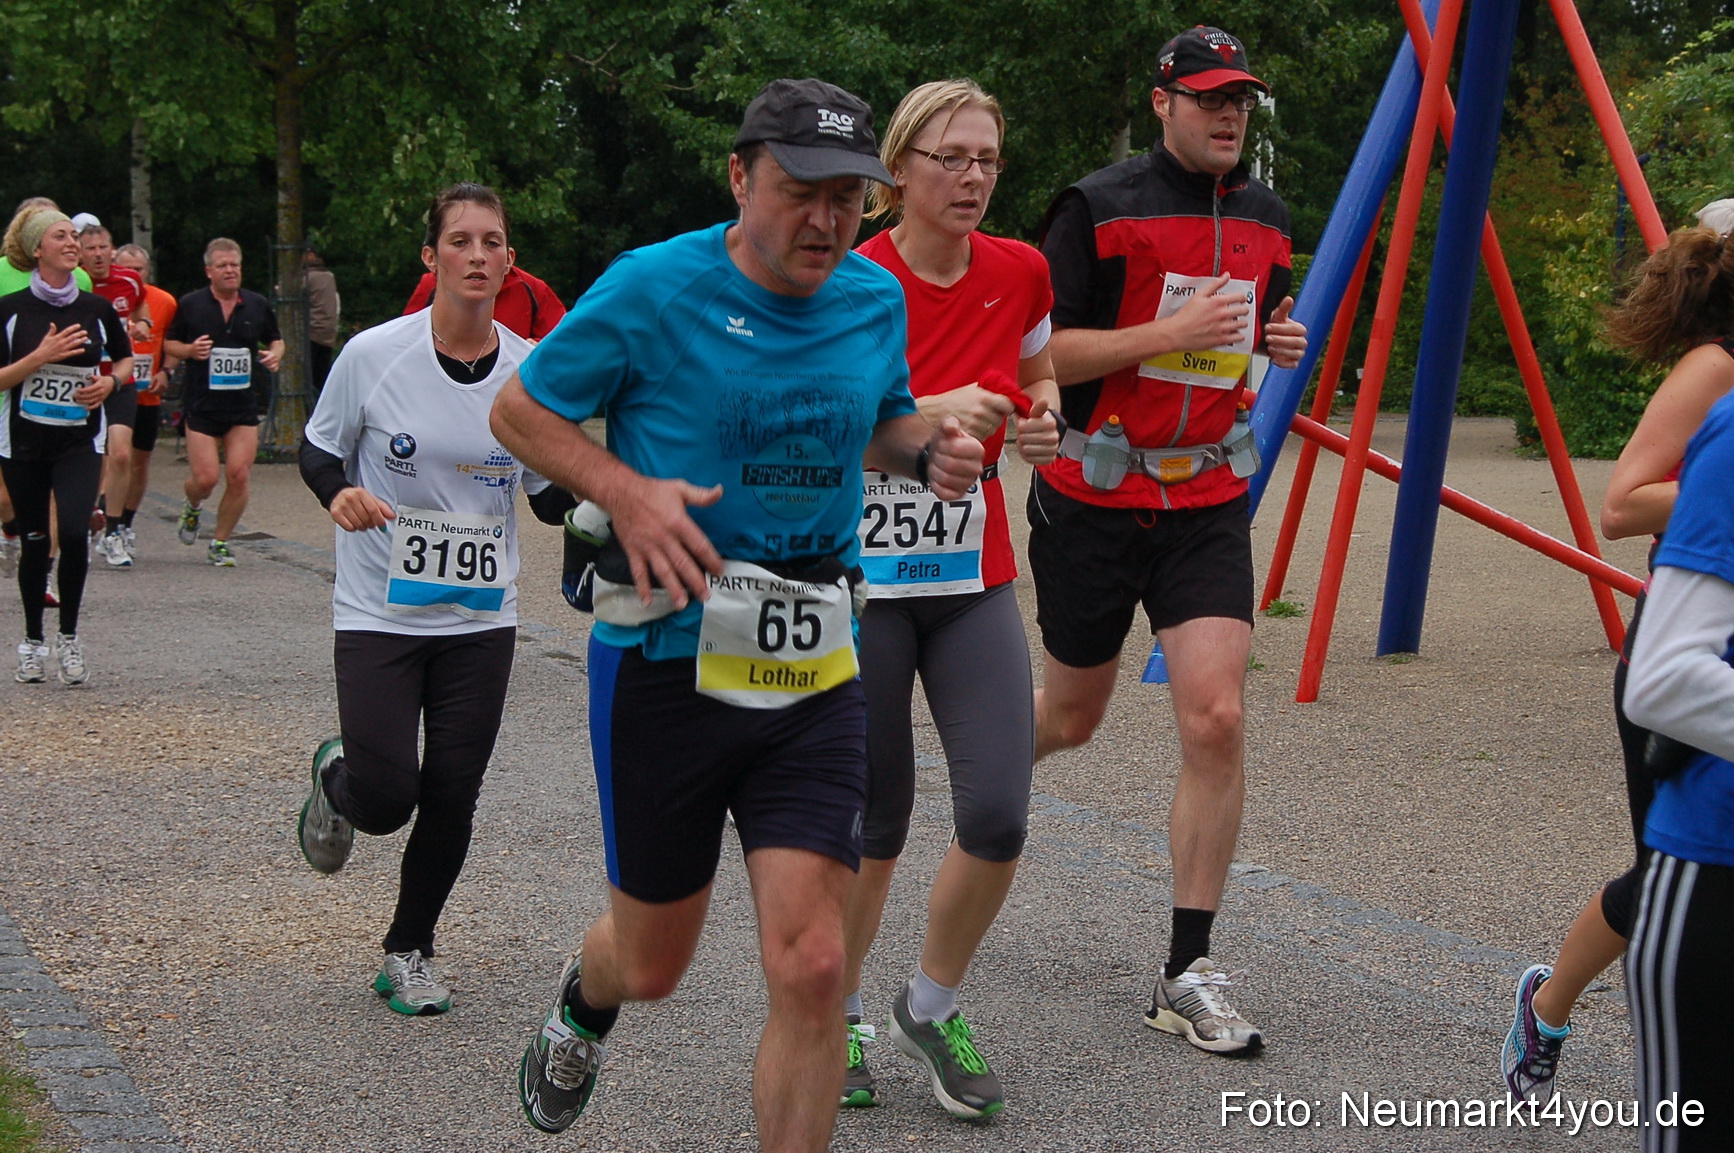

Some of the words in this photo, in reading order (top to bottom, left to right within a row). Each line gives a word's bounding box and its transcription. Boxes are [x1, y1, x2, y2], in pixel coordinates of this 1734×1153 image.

[817, 108, 853, 126] TAO
[214, 358, 249, 374] 3048
[1182, 352, 1217, 372] Sven
[786, 443, 810, 459] 15.
[384, 456, 417, 472] PARTL
[455, 463, 473, 474] 14.
[748, 465, 801, 487] FINISH
[806, 467, 842, 488] LINE
[397, 516, 438, 532] PARTL
[441, 522, 490, 537] Neumarkt
[863, 500, 973, 549] 2547
[403, 534, 498, 583] 3196
[897, 561, 940, 579] Petra
[710, 575, 764, 592] PARTL
[757, 598, 822, 653] 65
[749, 663, 818, 687] Lothar
